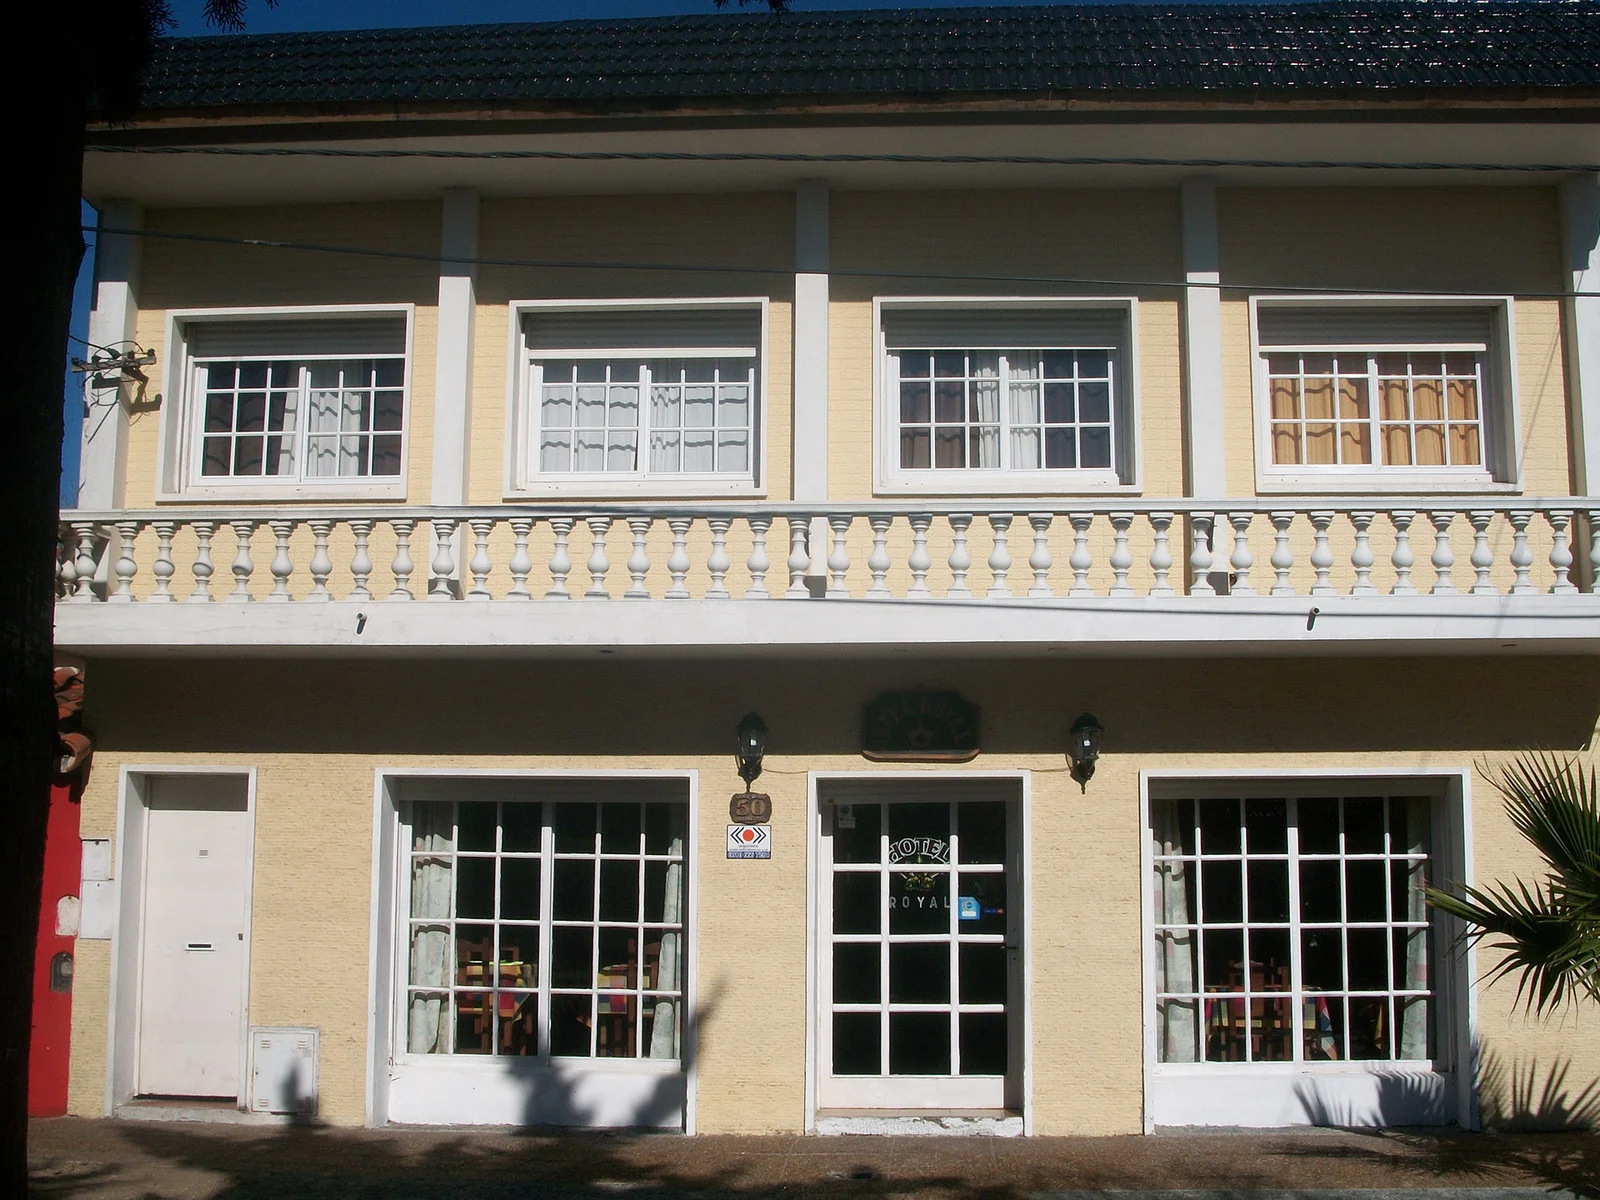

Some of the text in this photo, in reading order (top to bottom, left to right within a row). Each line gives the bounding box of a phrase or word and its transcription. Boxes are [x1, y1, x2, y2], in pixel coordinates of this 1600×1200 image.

[735, 798, 766, 816] 50
[889, 837, 950, 864] HOTEL
[889, 896, 950, 908] ROYAL
